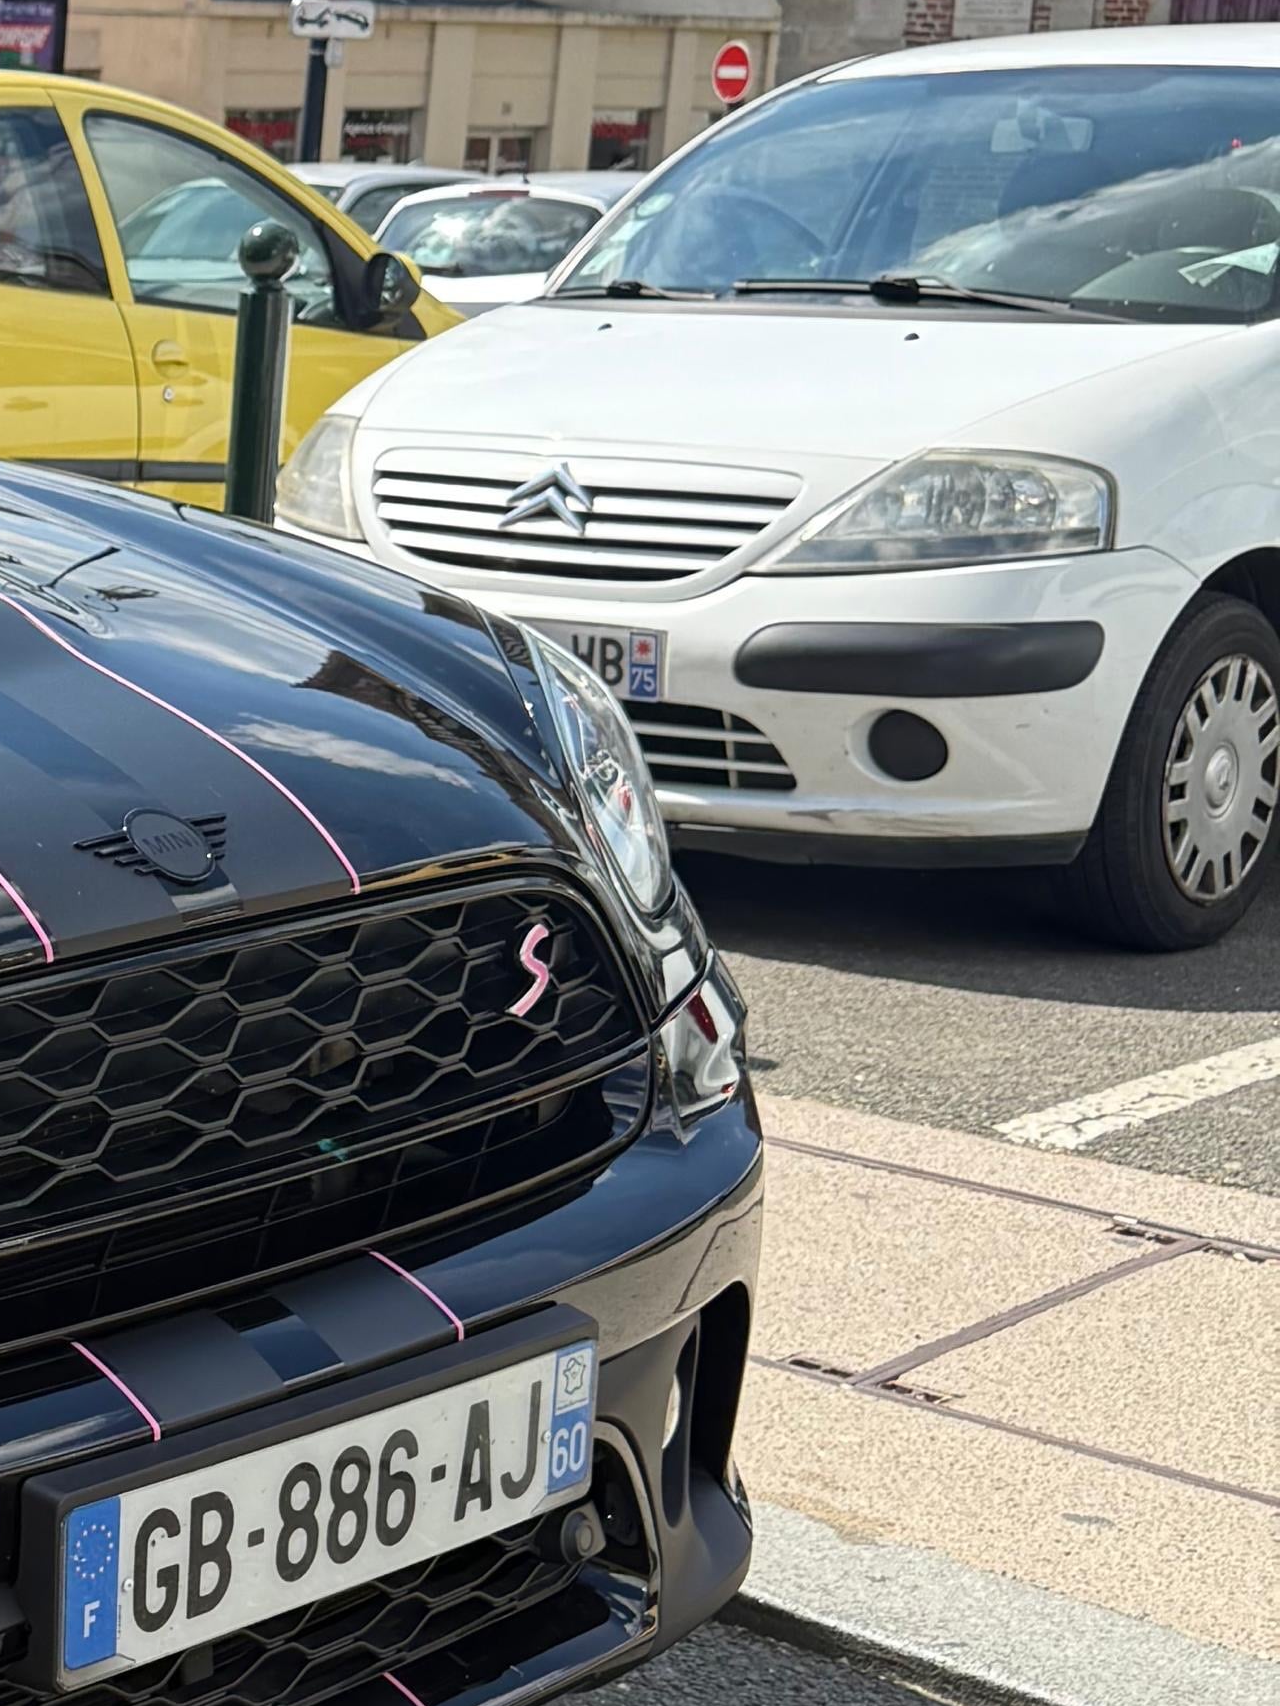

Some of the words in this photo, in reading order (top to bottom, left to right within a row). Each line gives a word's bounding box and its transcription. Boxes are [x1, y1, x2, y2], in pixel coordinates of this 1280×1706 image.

[631, 667, 655, 692] 75
[141, 830, 200, 854] MINI
[551, 1421, 588, 1479] 60
[132, 1380, 543, 1633] GB-886-AJ
[83, 1600, 101, 1638] F
